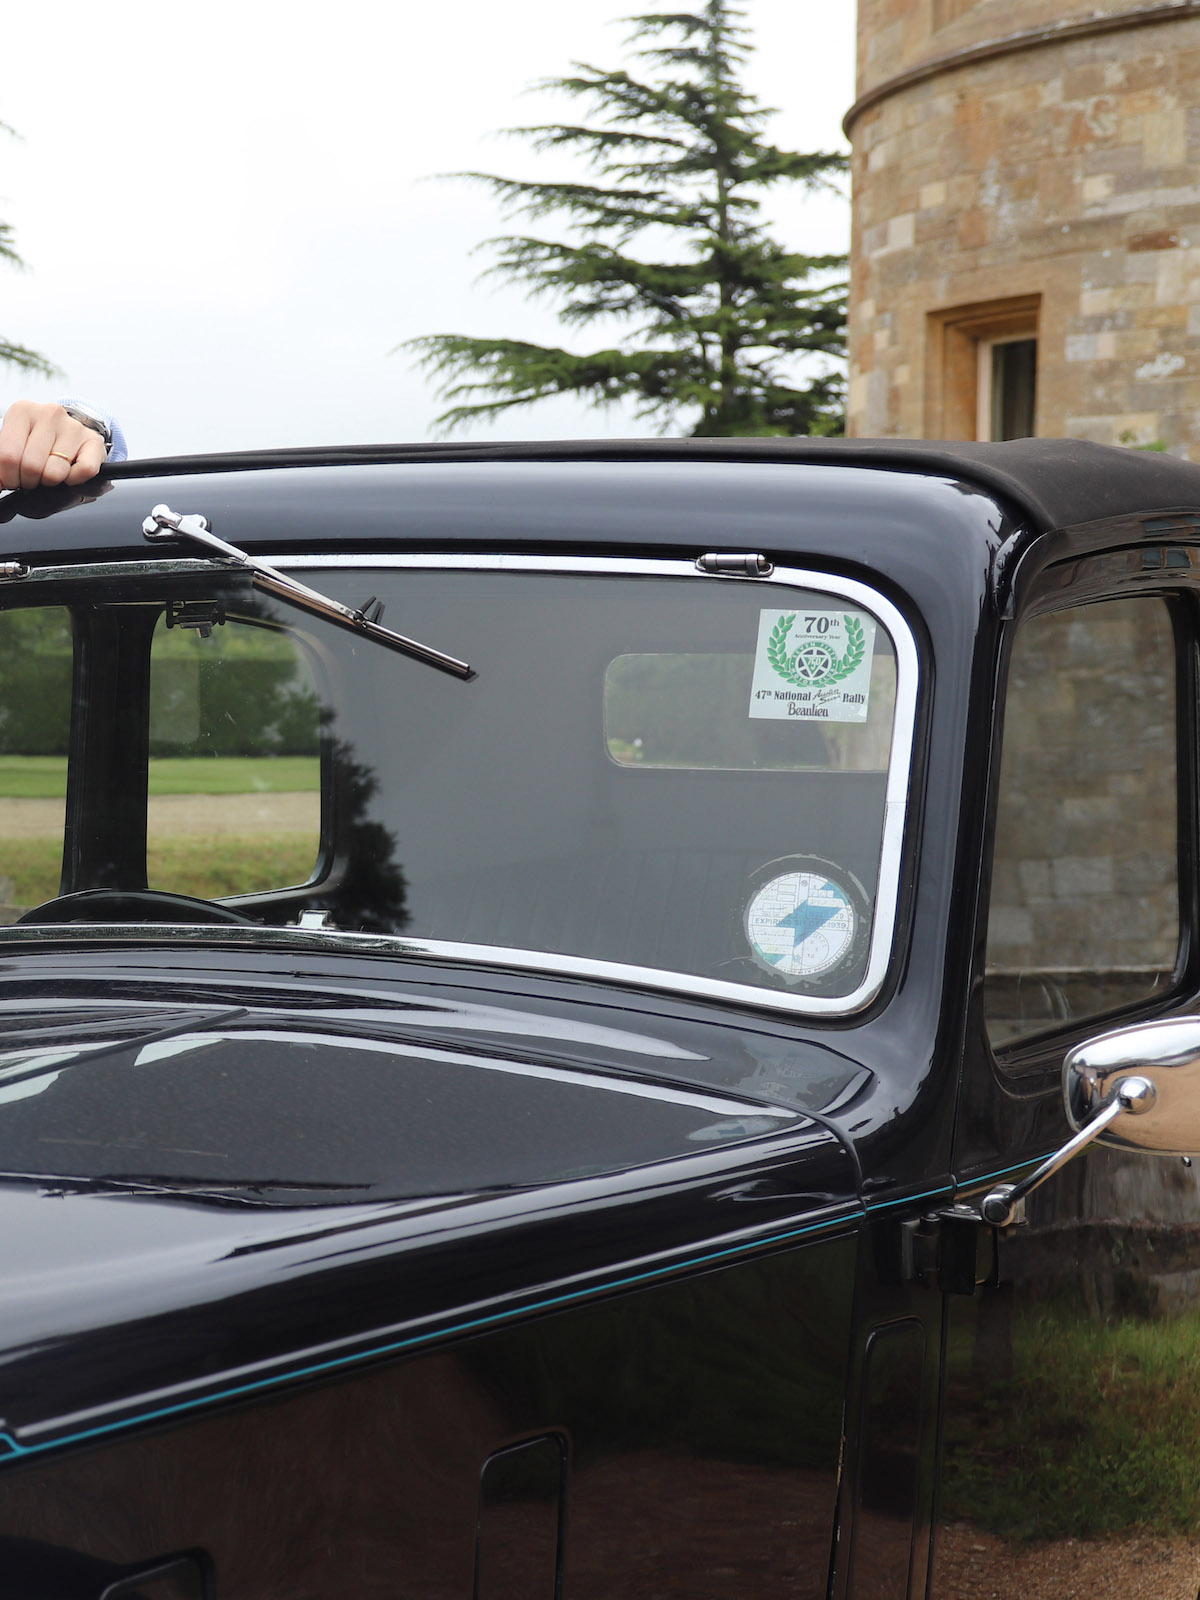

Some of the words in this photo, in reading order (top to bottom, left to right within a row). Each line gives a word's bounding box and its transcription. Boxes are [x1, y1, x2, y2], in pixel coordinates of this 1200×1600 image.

[804, 616, 840, 634] 70th
[808, 657, 821, 670] 750
[818, 668, 835, 684] CLUB
[755, 690, 772, 698] 47th
[774, 690, 811, 701] National
[842, 693, 865, 705] Rally
[788, 701, 829, 717] Beaulieu
[755, 917, 792, 926] EXPIRING
